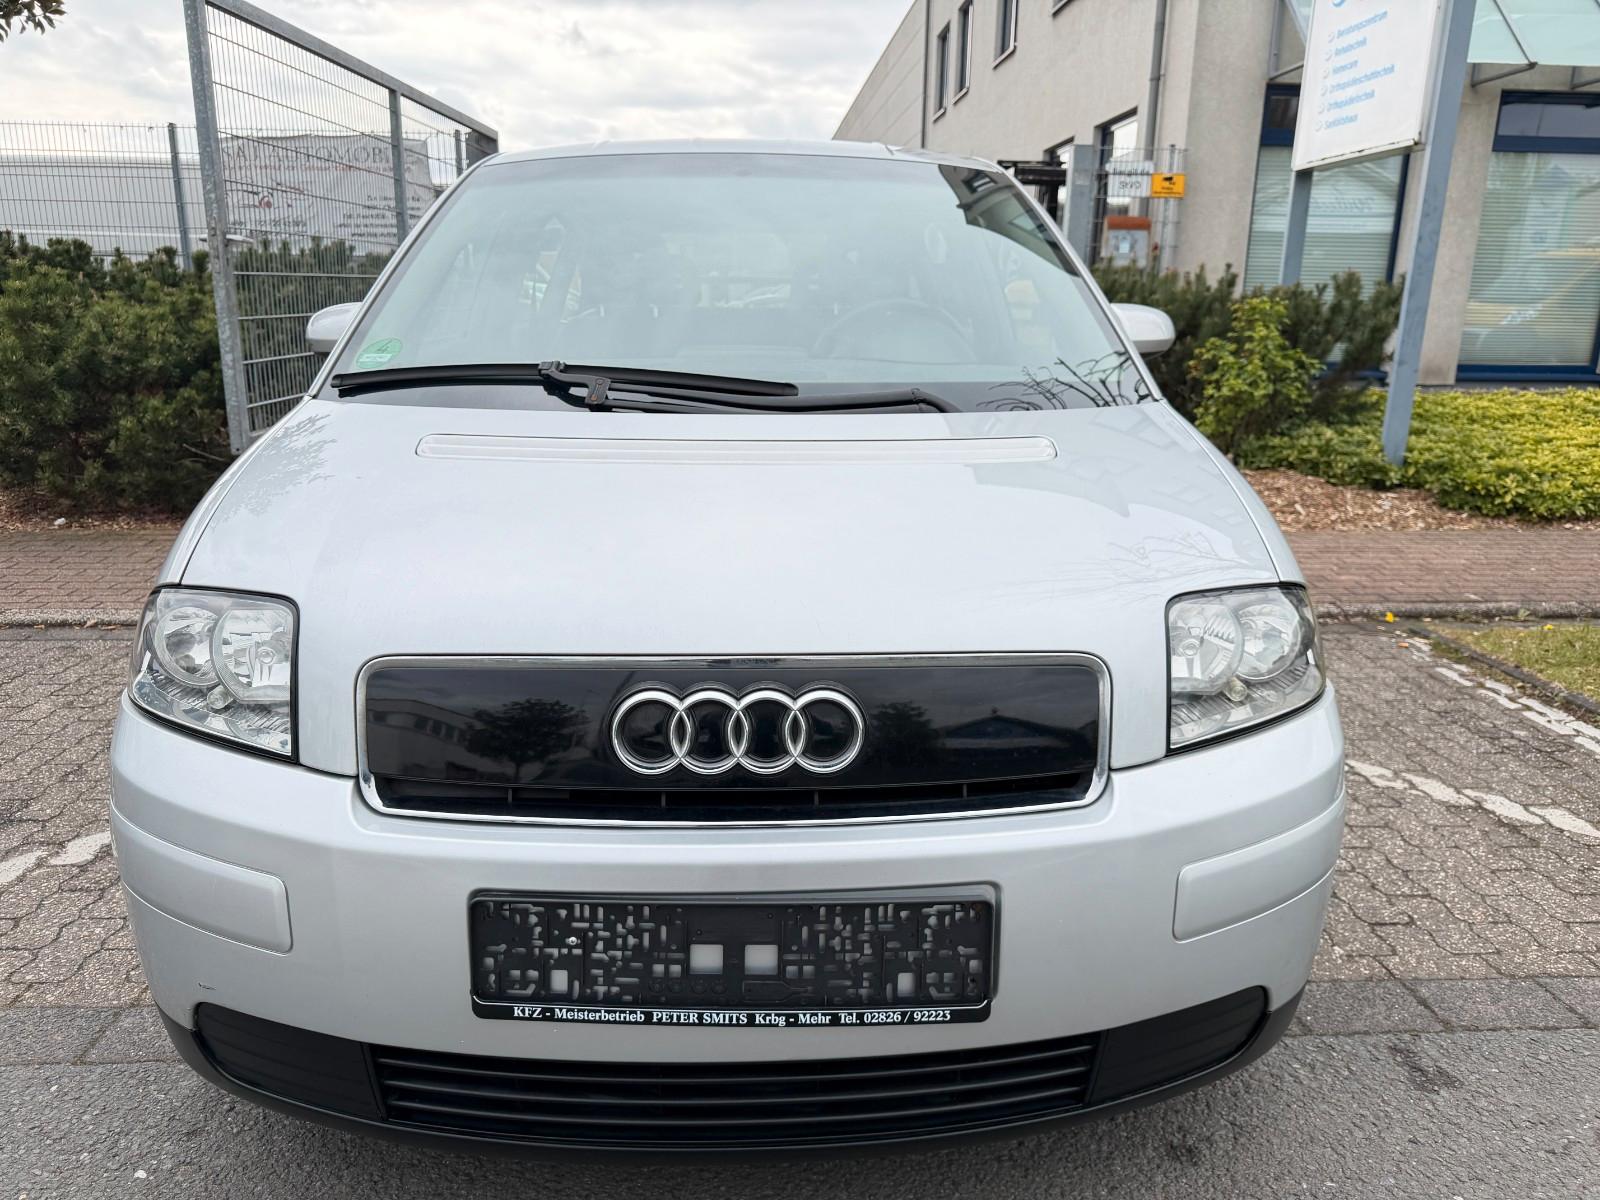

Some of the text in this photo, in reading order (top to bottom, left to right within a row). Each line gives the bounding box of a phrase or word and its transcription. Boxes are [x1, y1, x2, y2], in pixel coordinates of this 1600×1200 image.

[513, 1006, 543, 1018] KFZ
[554, 1009, 646, 1022] Meisterbetrieb
[652, 1011, 699, 1024] PETER
[702, 1012, 748, 1024] SMITS
[755, 1013, 787, 1027] Krbg
[798, 1013, 832, 1024] Mehr
[839, 1012, 860, 1024] Tel.
[863, 1011, 902, 1023] 02826
[903, 1011, 911, 1023] /
[913, 1010, 951, 1022] 92223
